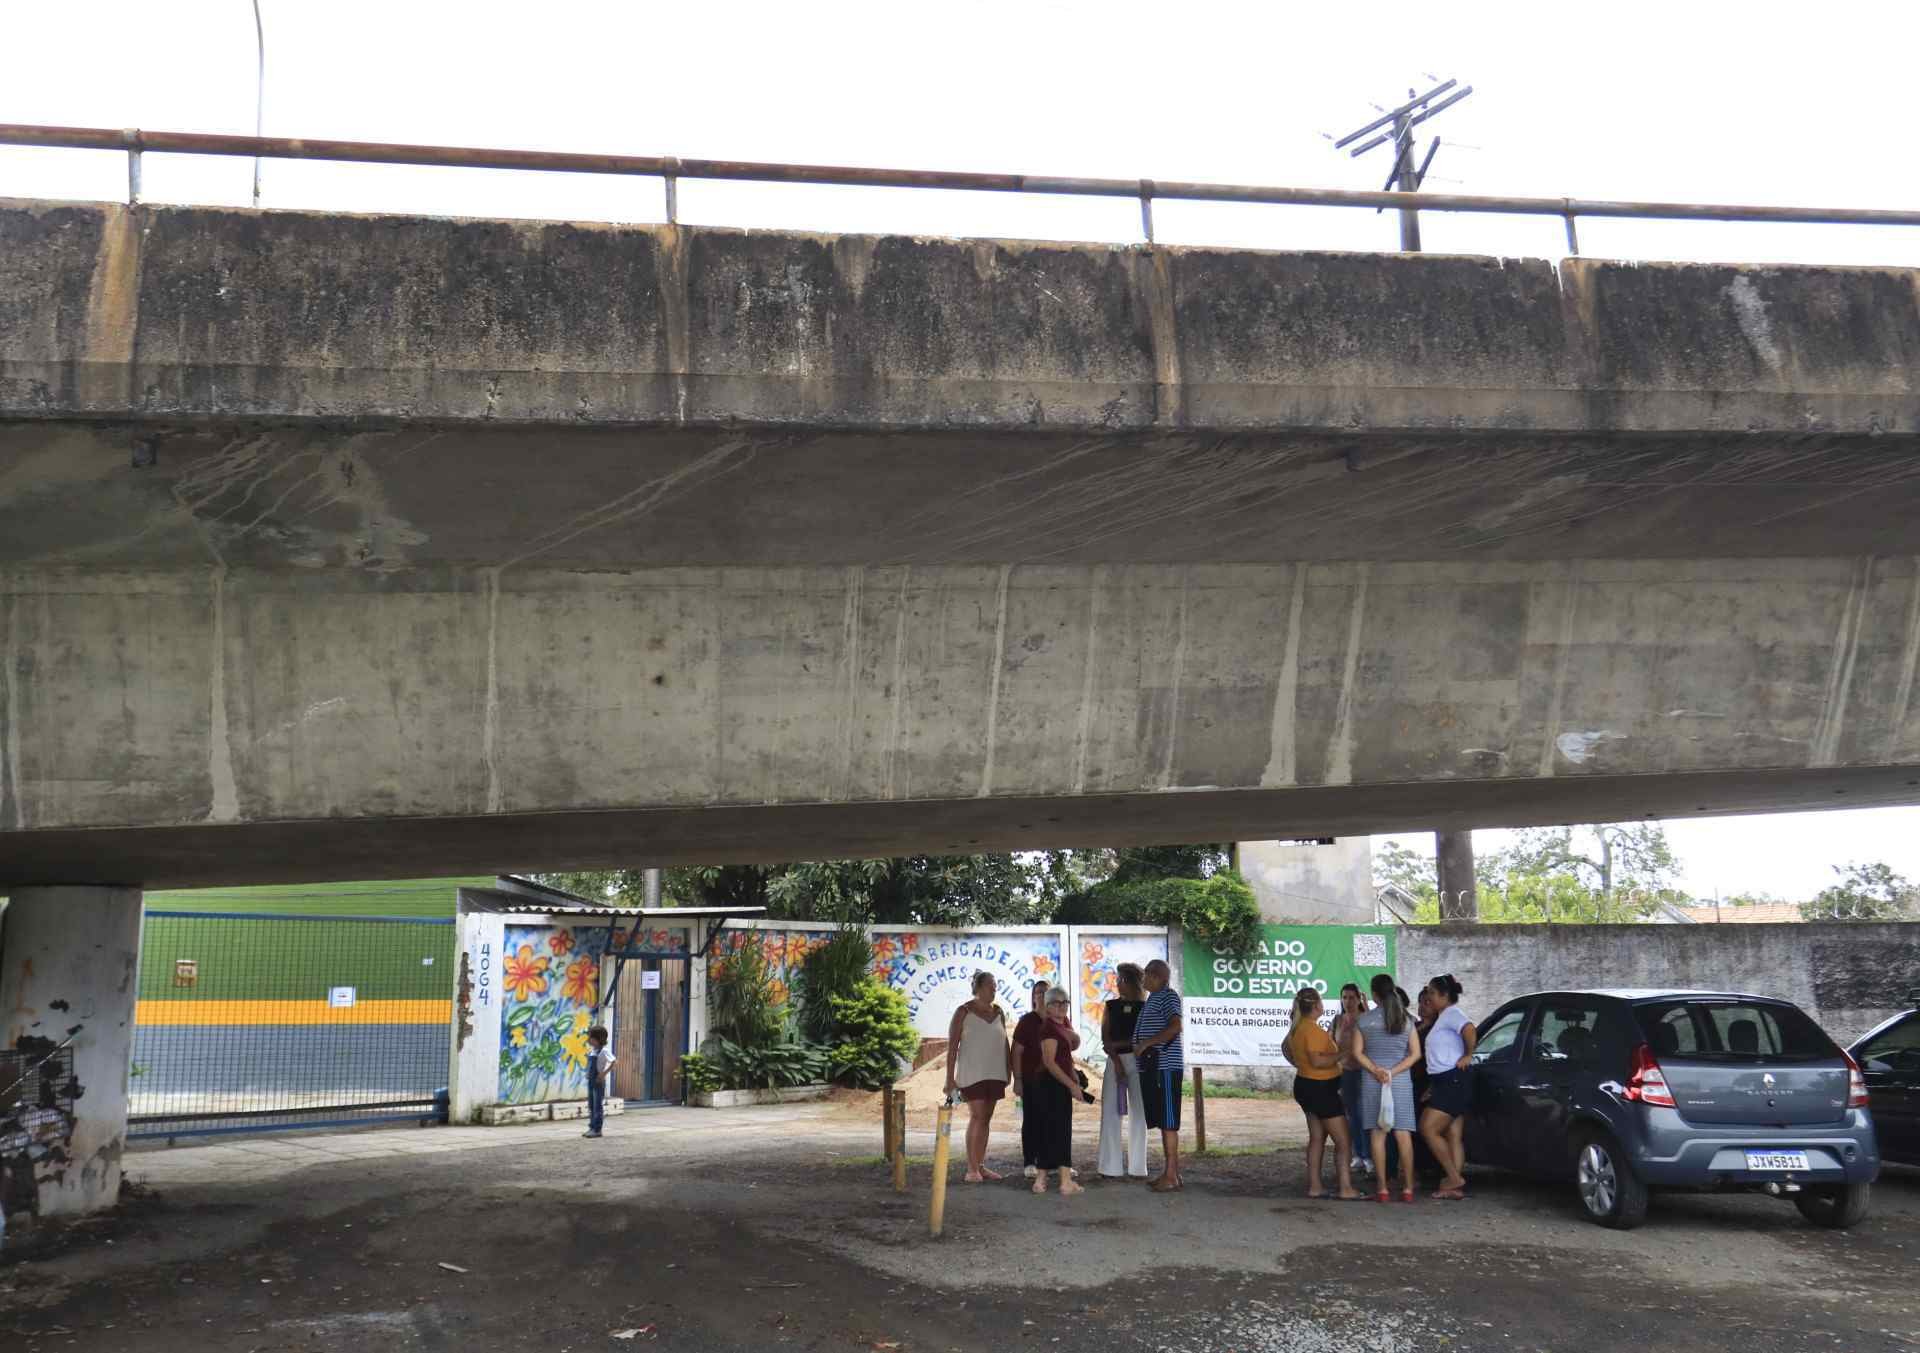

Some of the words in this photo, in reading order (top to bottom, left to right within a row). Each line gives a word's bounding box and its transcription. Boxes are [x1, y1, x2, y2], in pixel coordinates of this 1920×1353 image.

[1274, 940, 1305, 956] DO
[479, 943, 490, 1005] 4064
[928, 942, 1035, 990] BRIGADEIRO
[1213, 959, 1313, 976] GOVERNO
[919, 966, 968, 994] GOMES
[1213, 977, 1244, 993] DO
[1248, 978, 1328, 994] ESTADO
[1190, 1005, 1235, 1016] EXECUÇÃO
[1249, 1008, 1292, 1016] CONSERV
[1190, 1017, 1203, 1025] NA
[1205, 1018, 1240, 1027] ESCOLA
[1241, 1019, 1290, 1028] BRIGADEIR
